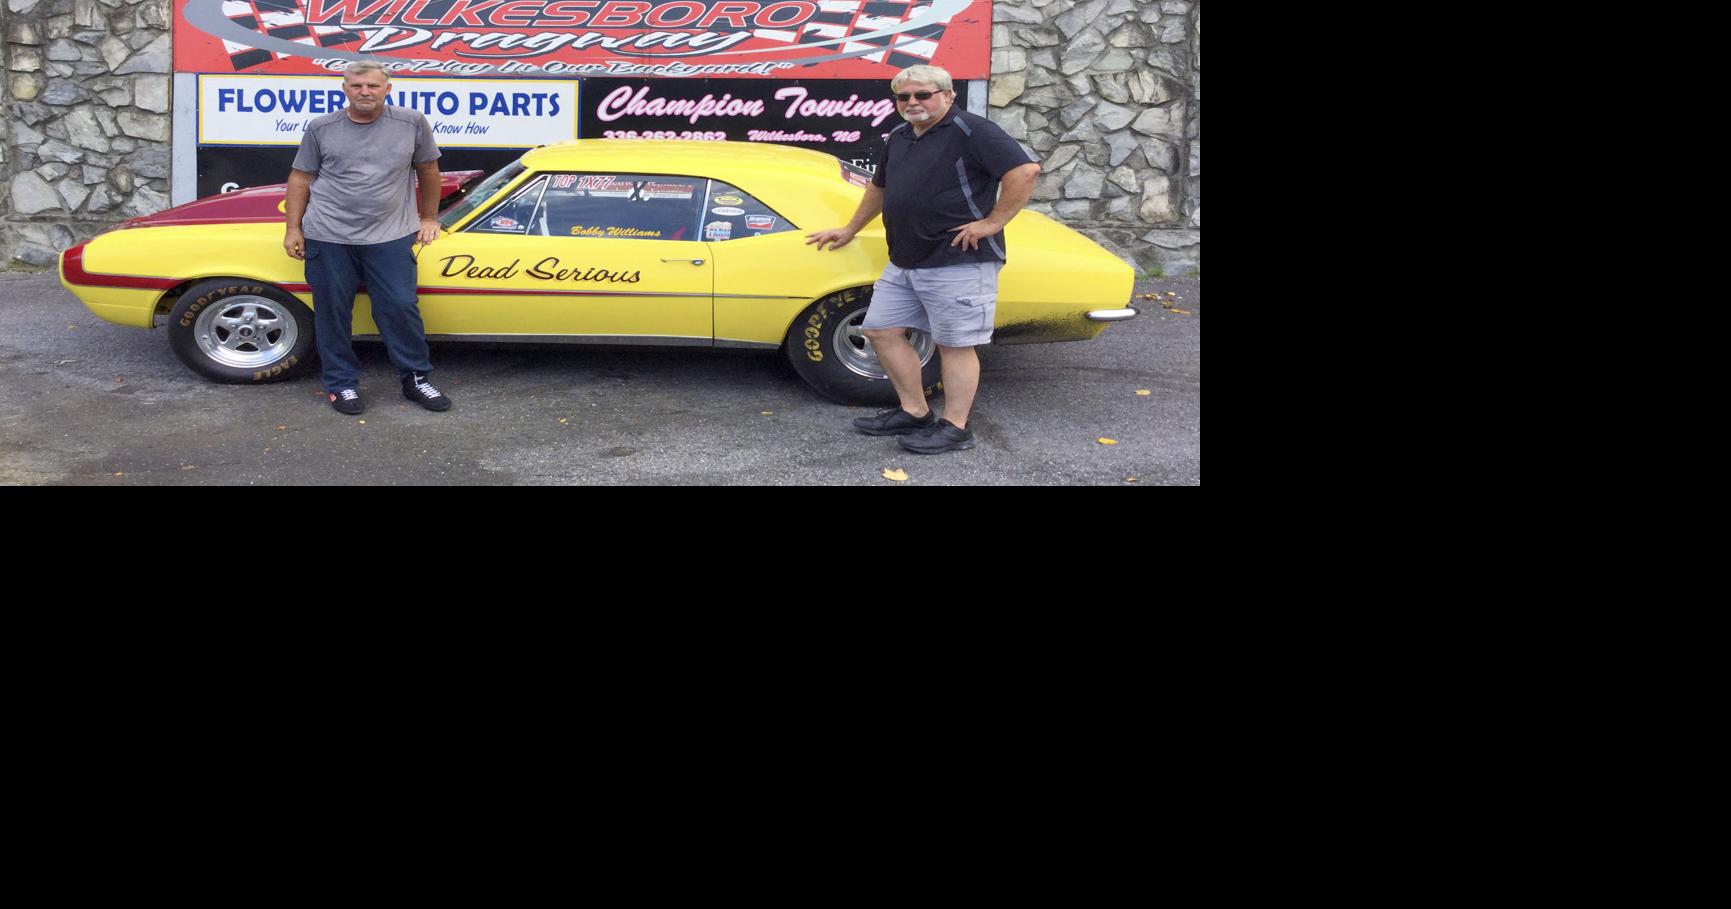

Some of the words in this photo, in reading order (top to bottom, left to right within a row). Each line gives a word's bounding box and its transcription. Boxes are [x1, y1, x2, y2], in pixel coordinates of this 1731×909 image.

[304, 0, 817, 27] WILKESBORO
[340, 24, 753, 59] Dragway
[409, 59, 494, 76] Play
[498, 60, 538, 73] In
[542, 60, 606, 75] Our
[217, 88, 349, 114] FLOWER
[469, 92, 561, 118] PARTS
[597, 86, 766, 125] Champion
[773, 86, 895, 128] Towing
[274, 119, 300, 133] Your
[432, 120, 462, 135] Know
[465, 122, 490, 136] How
[552, 174, 577, 188] TOP
[570, 225, 605, 236] Bobby
[606, 226, 661, 237] Williams
[439, 254, 520, 279] Dead
[525, 257, 641, 283] Serious
[252, 355, 298, 381] EAGLE
